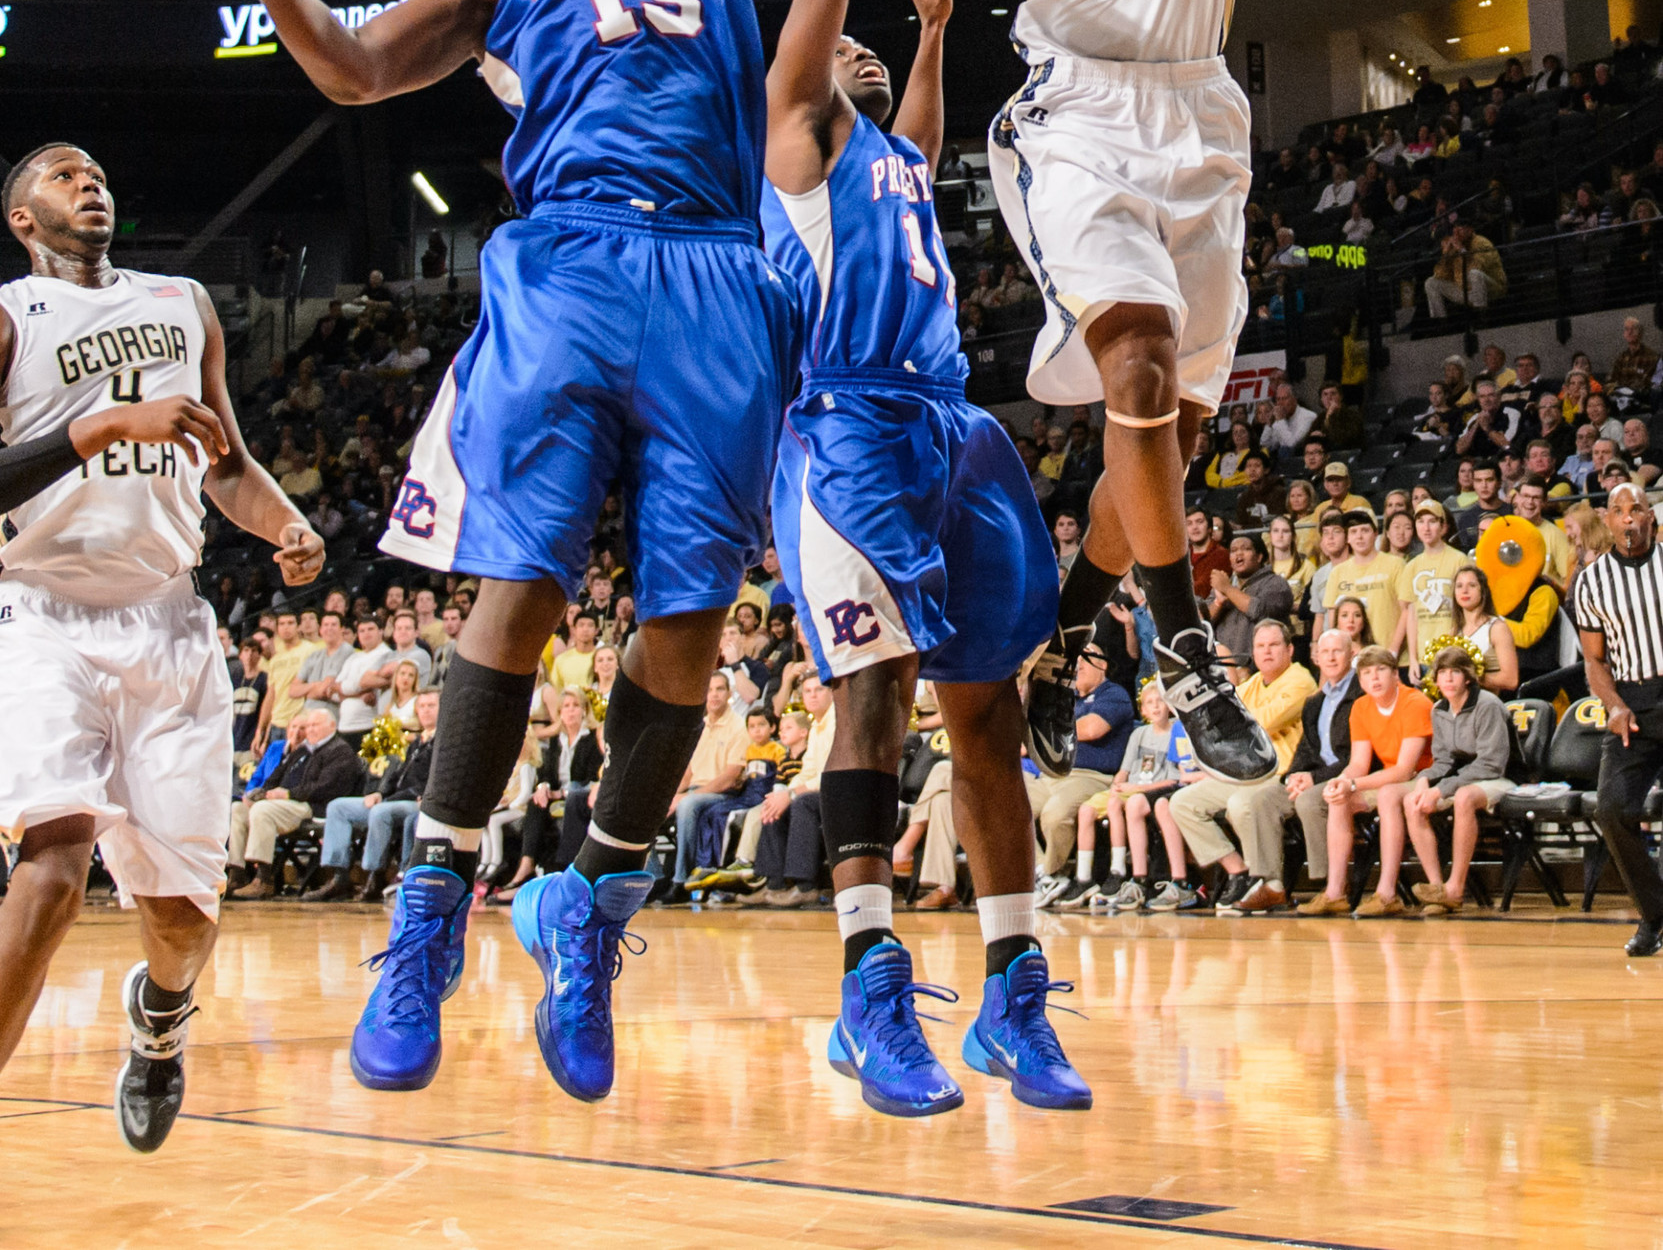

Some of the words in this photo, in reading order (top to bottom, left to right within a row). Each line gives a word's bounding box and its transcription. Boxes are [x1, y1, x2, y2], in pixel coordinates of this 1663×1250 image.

[56, 323, 188, 386] GEORGIA
[111, 368, 142, 404] 4
[391, 477, 438, 540] PC
[824, 598, 881, 648] PC
